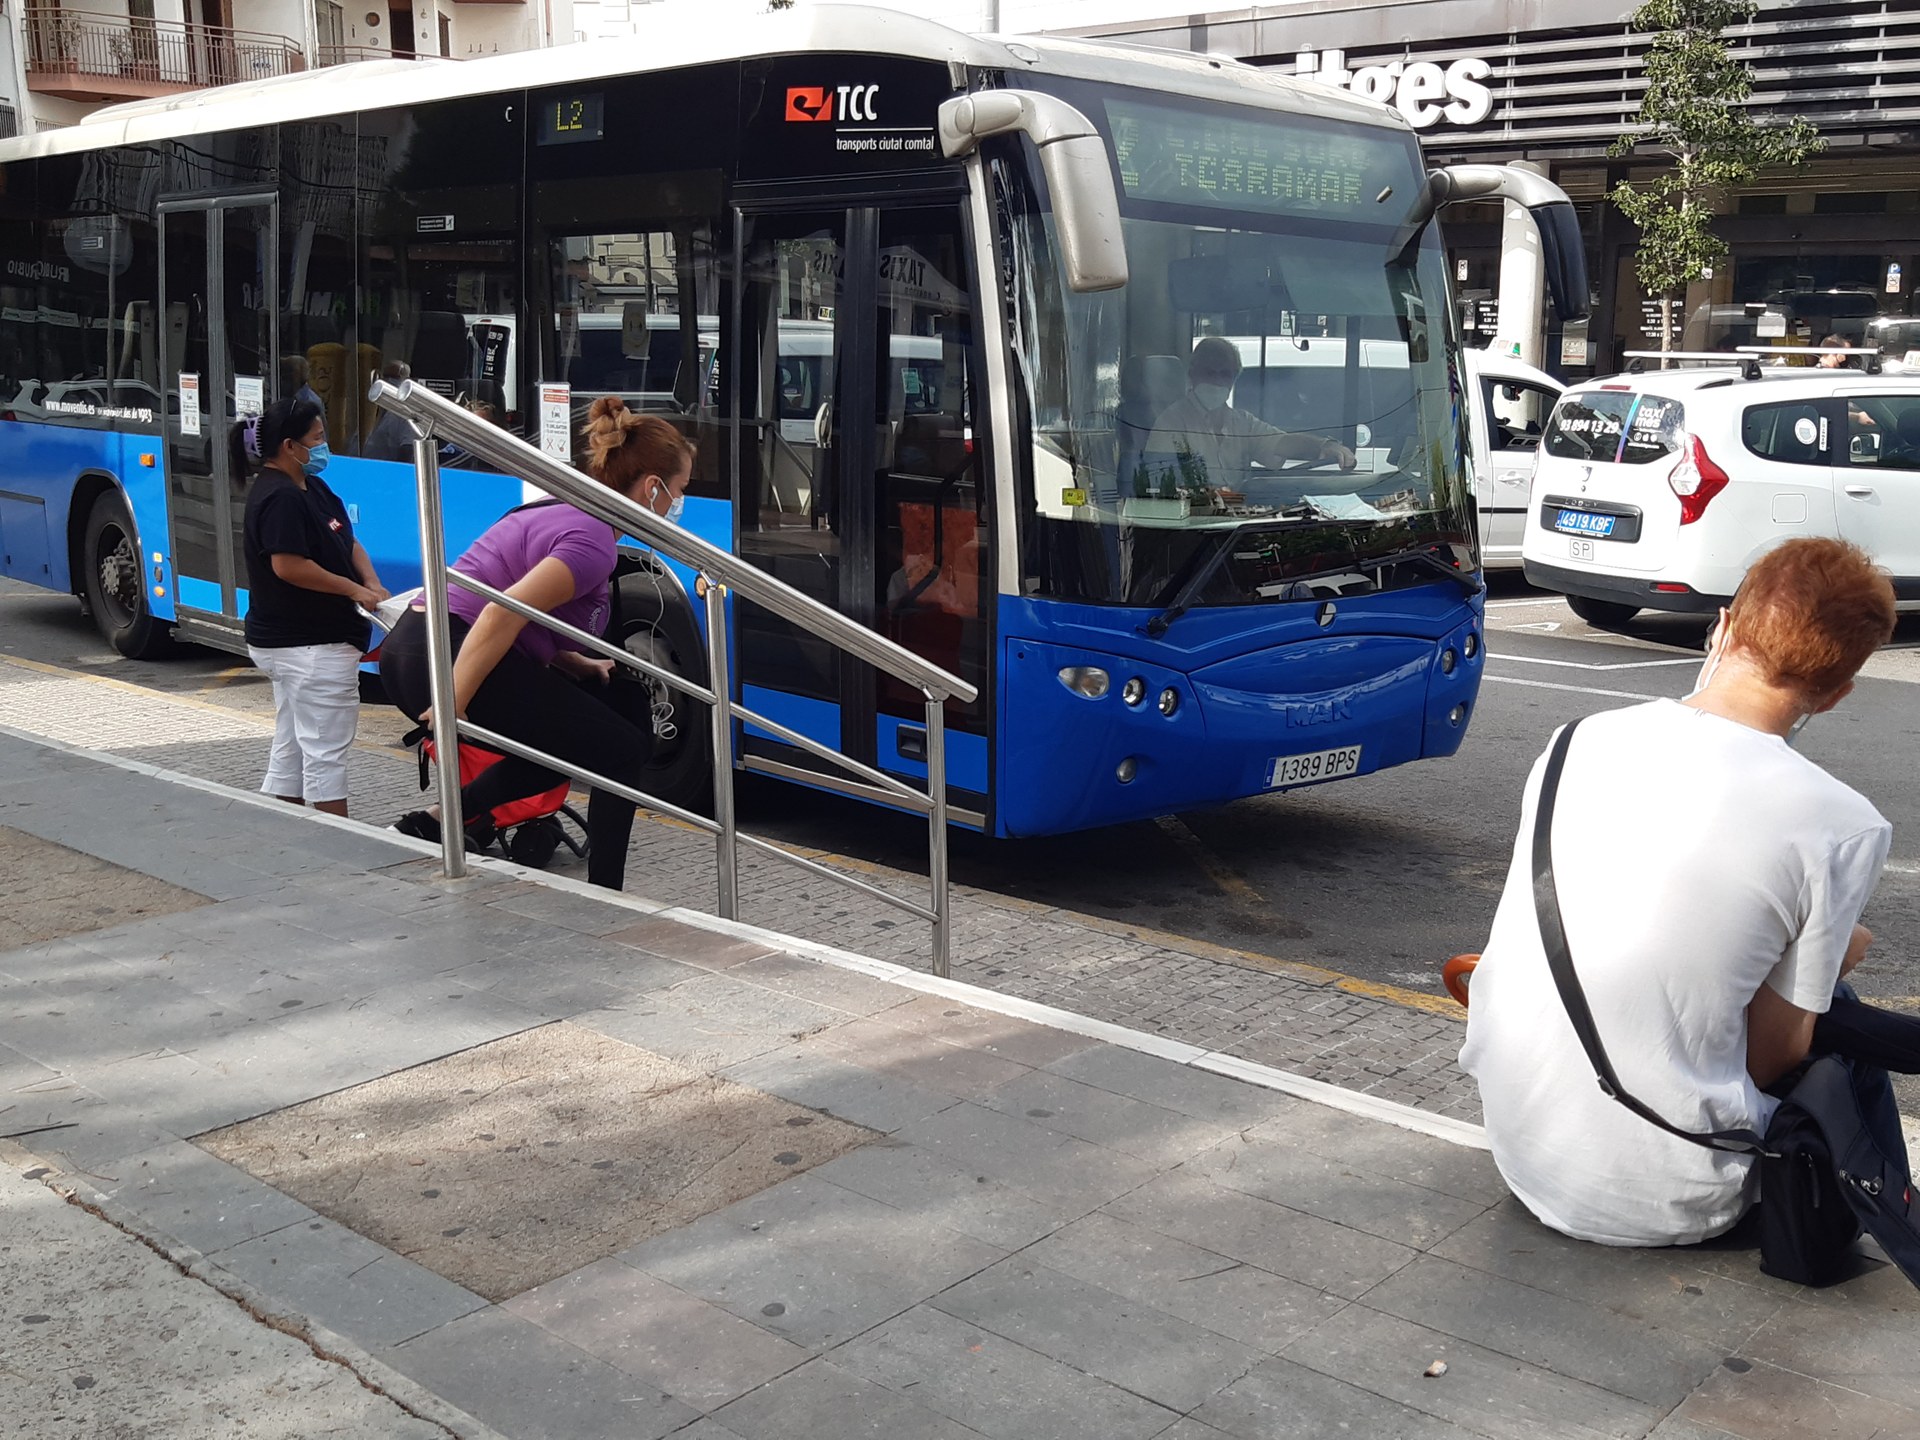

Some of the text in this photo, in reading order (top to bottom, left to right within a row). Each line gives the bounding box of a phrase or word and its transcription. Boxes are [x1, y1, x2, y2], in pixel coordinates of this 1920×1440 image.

[837, 84, 880, 121] TCC
[557, 100, 583, 131] L2
[836, 135, 935, 153] transports ciutat comtal
[1174, 152, 1364, 204] TERRAMAR
[45, 401, 95, 415] www.moventis.es
[138, 408, 153, 423] 1923
[1639, 405, 1666, 419] taxi
[1560, 419, 1620, 434] 93 894 13 29
[1562, 512, 1589, 530] 4919
[1589, 516, 1612, 532] KBF
[1572, 541, 1590, 557] SP
[1286, 697, 1354, 728] MAN
[1280, 749, 1357, 782] 1389 BPS
